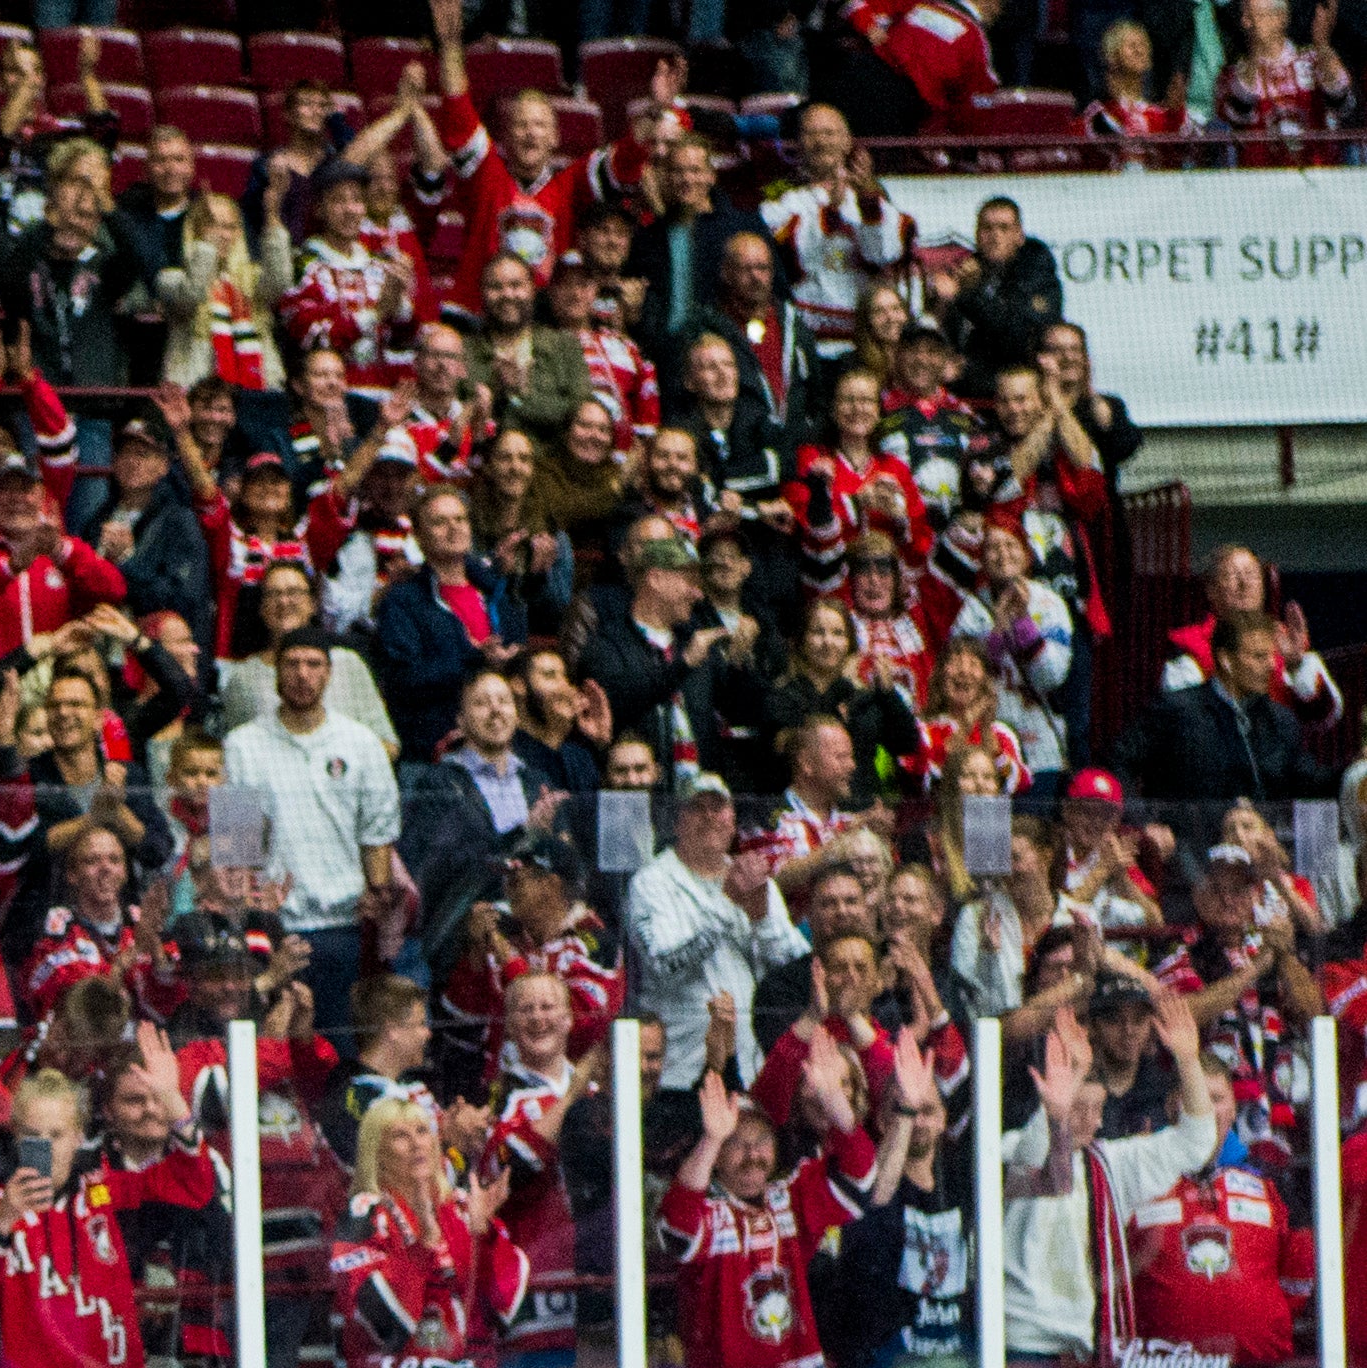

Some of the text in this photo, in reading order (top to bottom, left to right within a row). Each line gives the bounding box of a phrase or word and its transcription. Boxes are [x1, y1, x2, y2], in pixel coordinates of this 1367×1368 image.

[1052, 233, 1367, 284] ORPET SUPP
[1193, 314, 1320, 365] #41#
